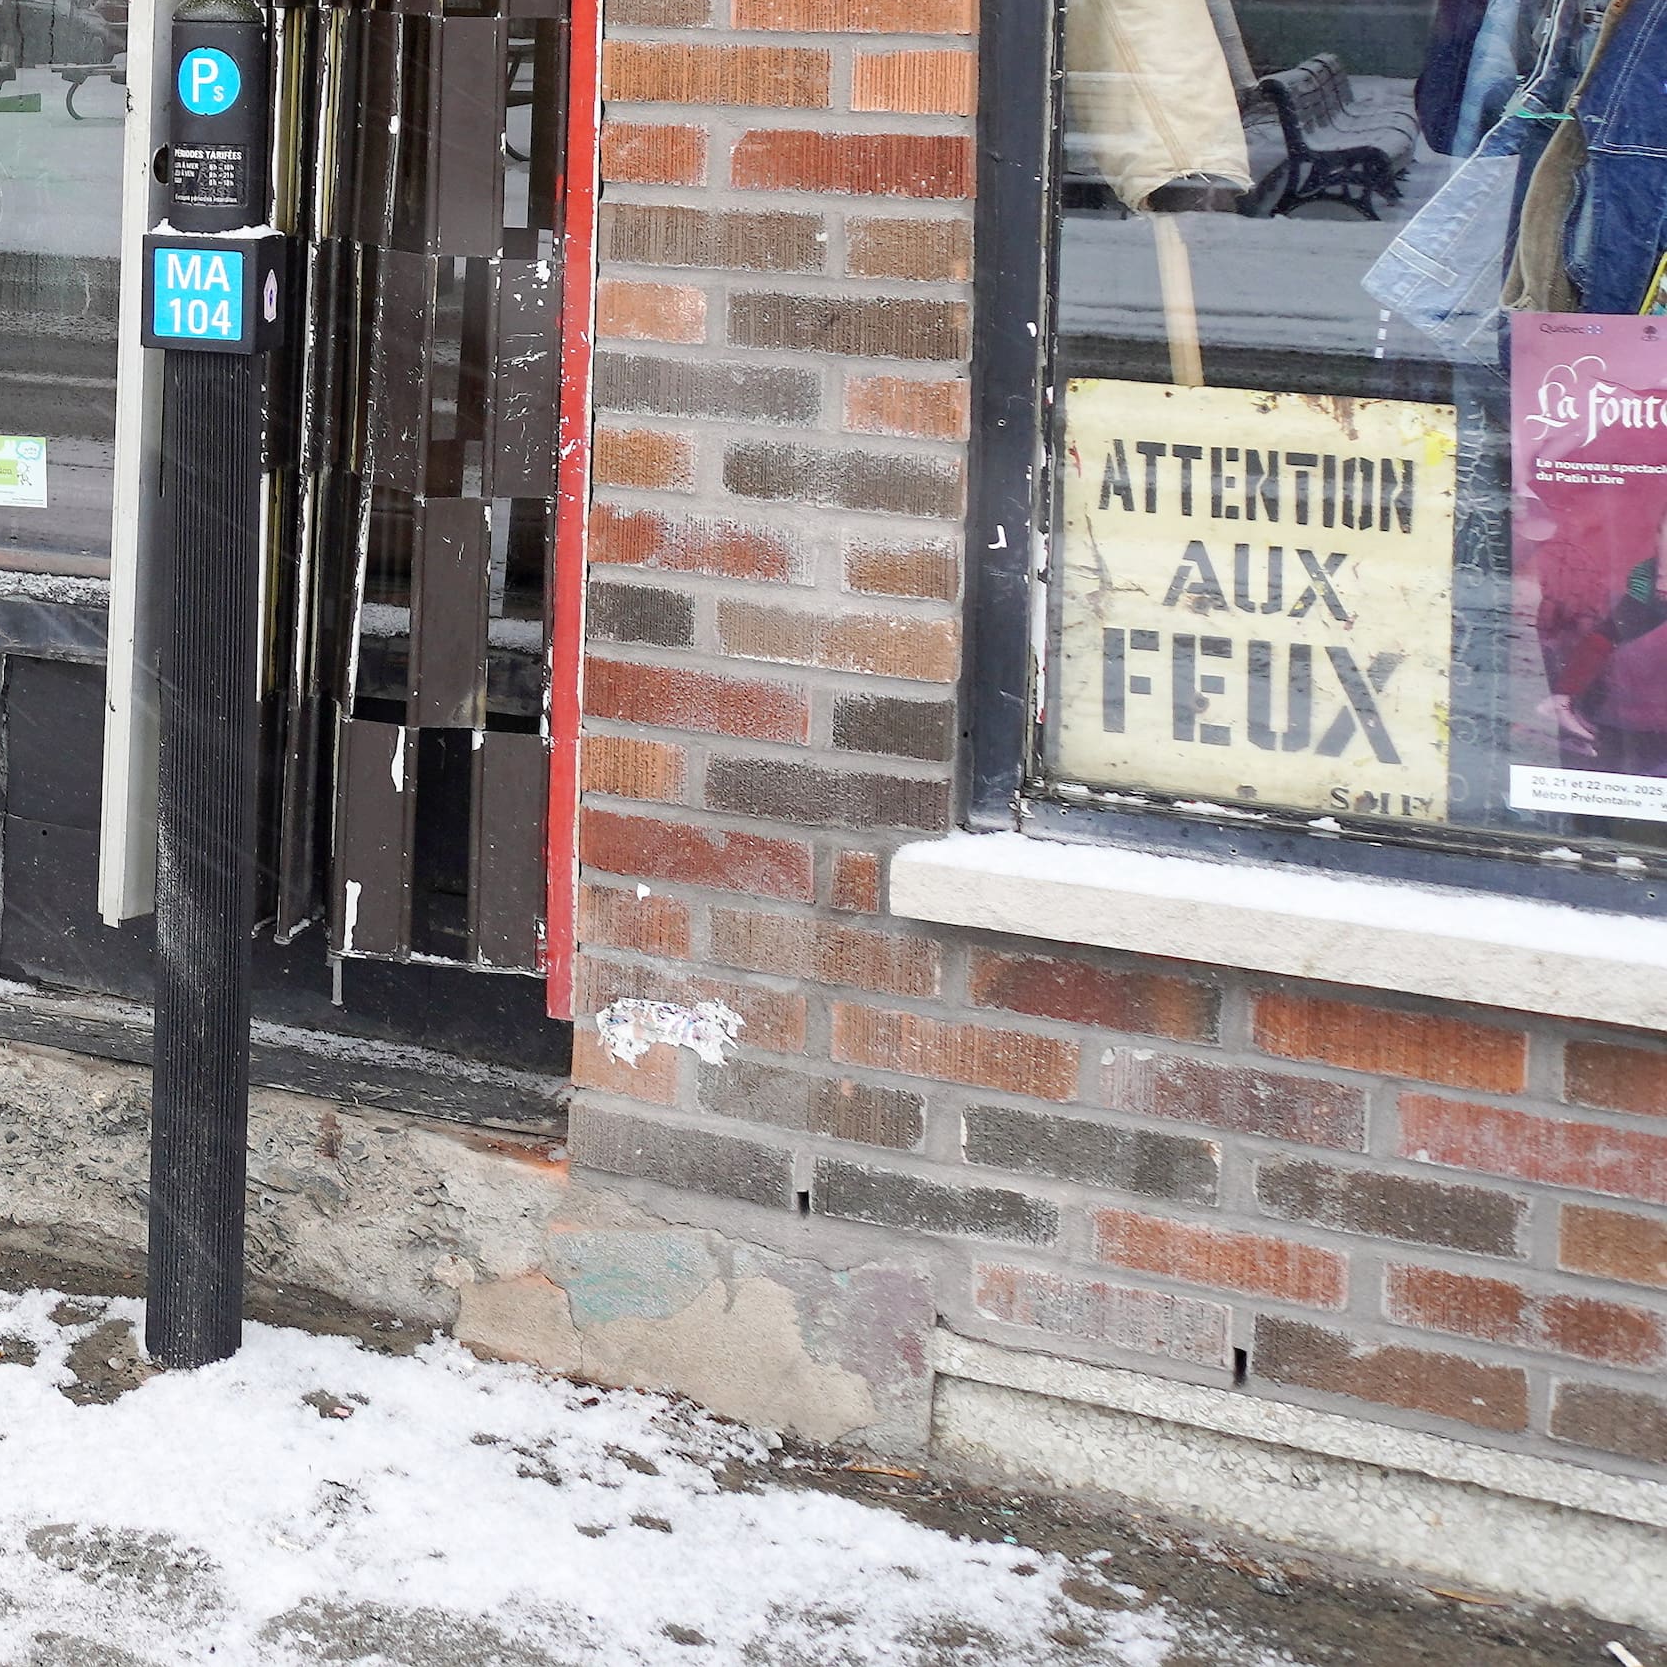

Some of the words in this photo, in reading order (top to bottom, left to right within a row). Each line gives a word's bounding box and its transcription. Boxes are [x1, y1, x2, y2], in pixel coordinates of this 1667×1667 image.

[168, 253, 232, 292] MA
[169, 298, 233, 336] 104
[1536, 457, 1553, 469] Le
[1554, 460, 1610, 472] nouveau
[1536, 471, 1554, 482] du
[1556, 472, 1589, 484] Patin
[1591, 473, 1625, 485] Libre
[1097, 438, 1414, 535] ATTENTION
[1162, 539, 1351, 622] AUX
[1101, 626, 1409, 765] FEUX
[1553, 777, 1567, 787] 21
[1571, 780, 1583, 789] et
[1586, 780, 1602, 790] 22
[1634, 784, 1664, 796] 2025
